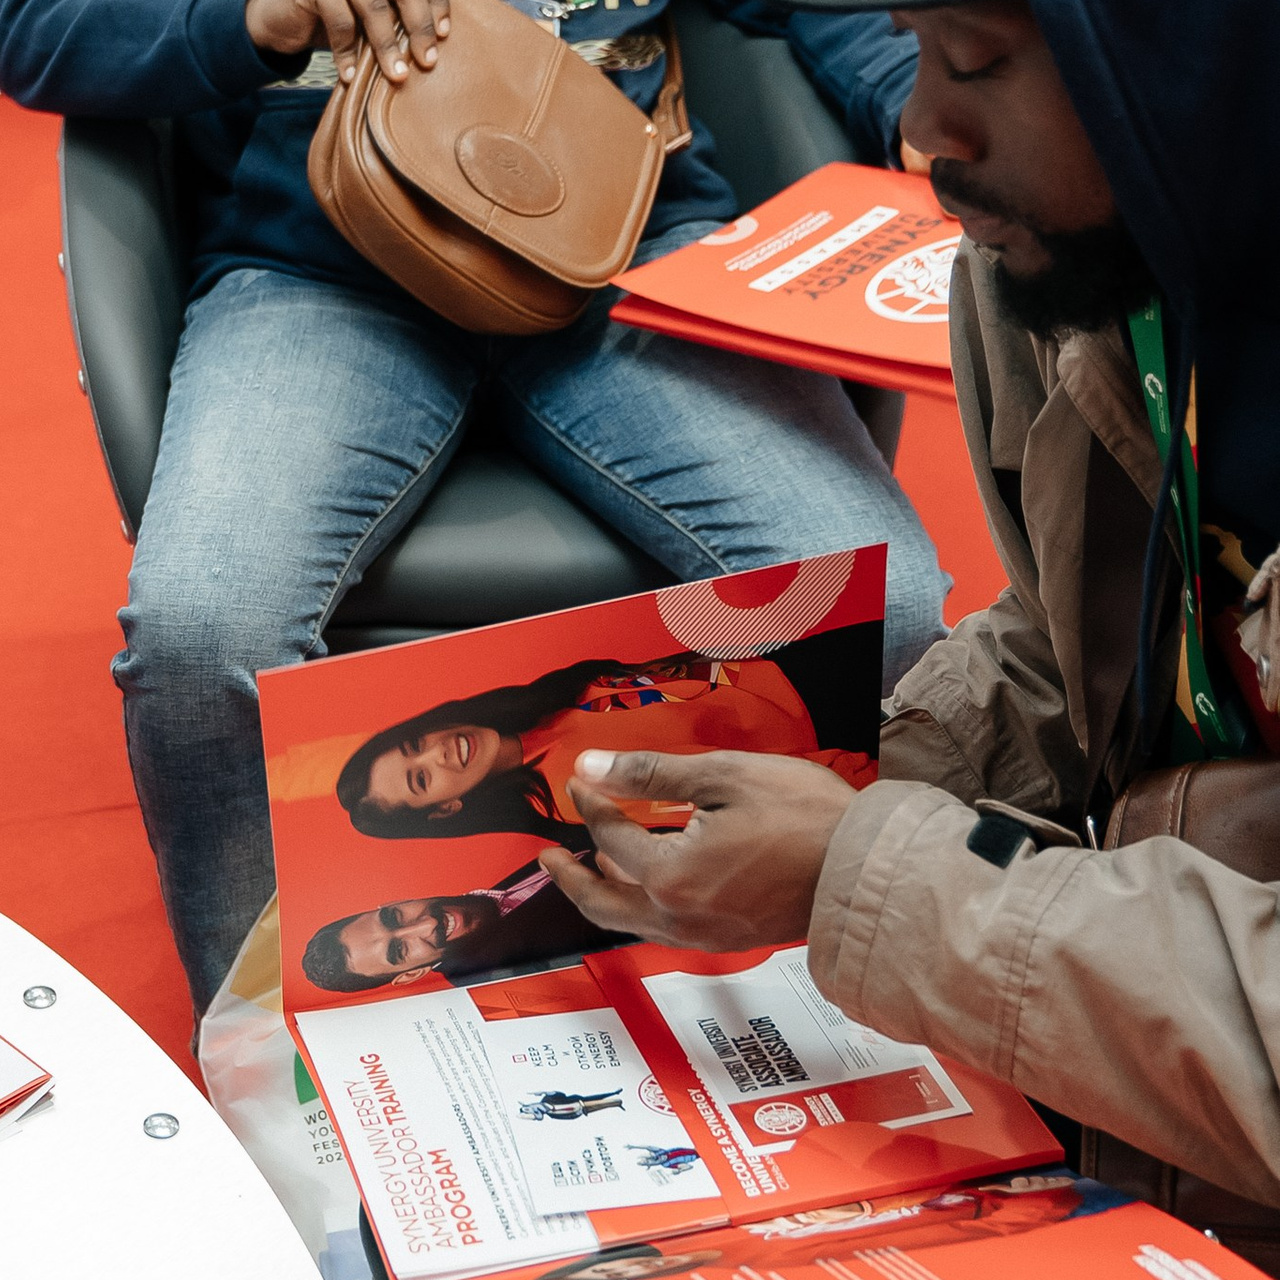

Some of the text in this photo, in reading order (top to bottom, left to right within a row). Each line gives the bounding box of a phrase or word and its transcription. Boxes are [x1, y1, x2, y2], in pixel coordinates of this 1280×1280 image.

[803, 217, 943, 300] SYNERGY
[528, 1046, 543, 1067] KEEP
[542, 1043, 559, 1068] CALM
[568, 1035, 591, 1070] ОТКРОЙ
[583, 1031, 606, 1069] SYNERGY
[598, 1030, 621, 1067] EMBASSY
[696, 1016, 758, 1093] SYNERGY UNIVERSITY
[731, 1033, 785, 1089] ASSOCIATE
[748, 1015, 811, 1083] AMBASSADOR
[450, 1103, 481, 1155] AMBASSADORS
[687, 1088, 727, 1136] SYNERGY
[316, 1152, 344, 1164] 202
[343, 1080, 431, 1254] SYNERGY UNIVERSITY
[359, 1053, 458, 1249] AMBASSADOR TRAINING
[731, 1150, 761, 1198] BECOME
[427, 1148, 484, 1246] PROGRAM
[474, 1156, 500, 1202] UNIVERSITY
[493, 1202, 516, 1240] SYNERGY
